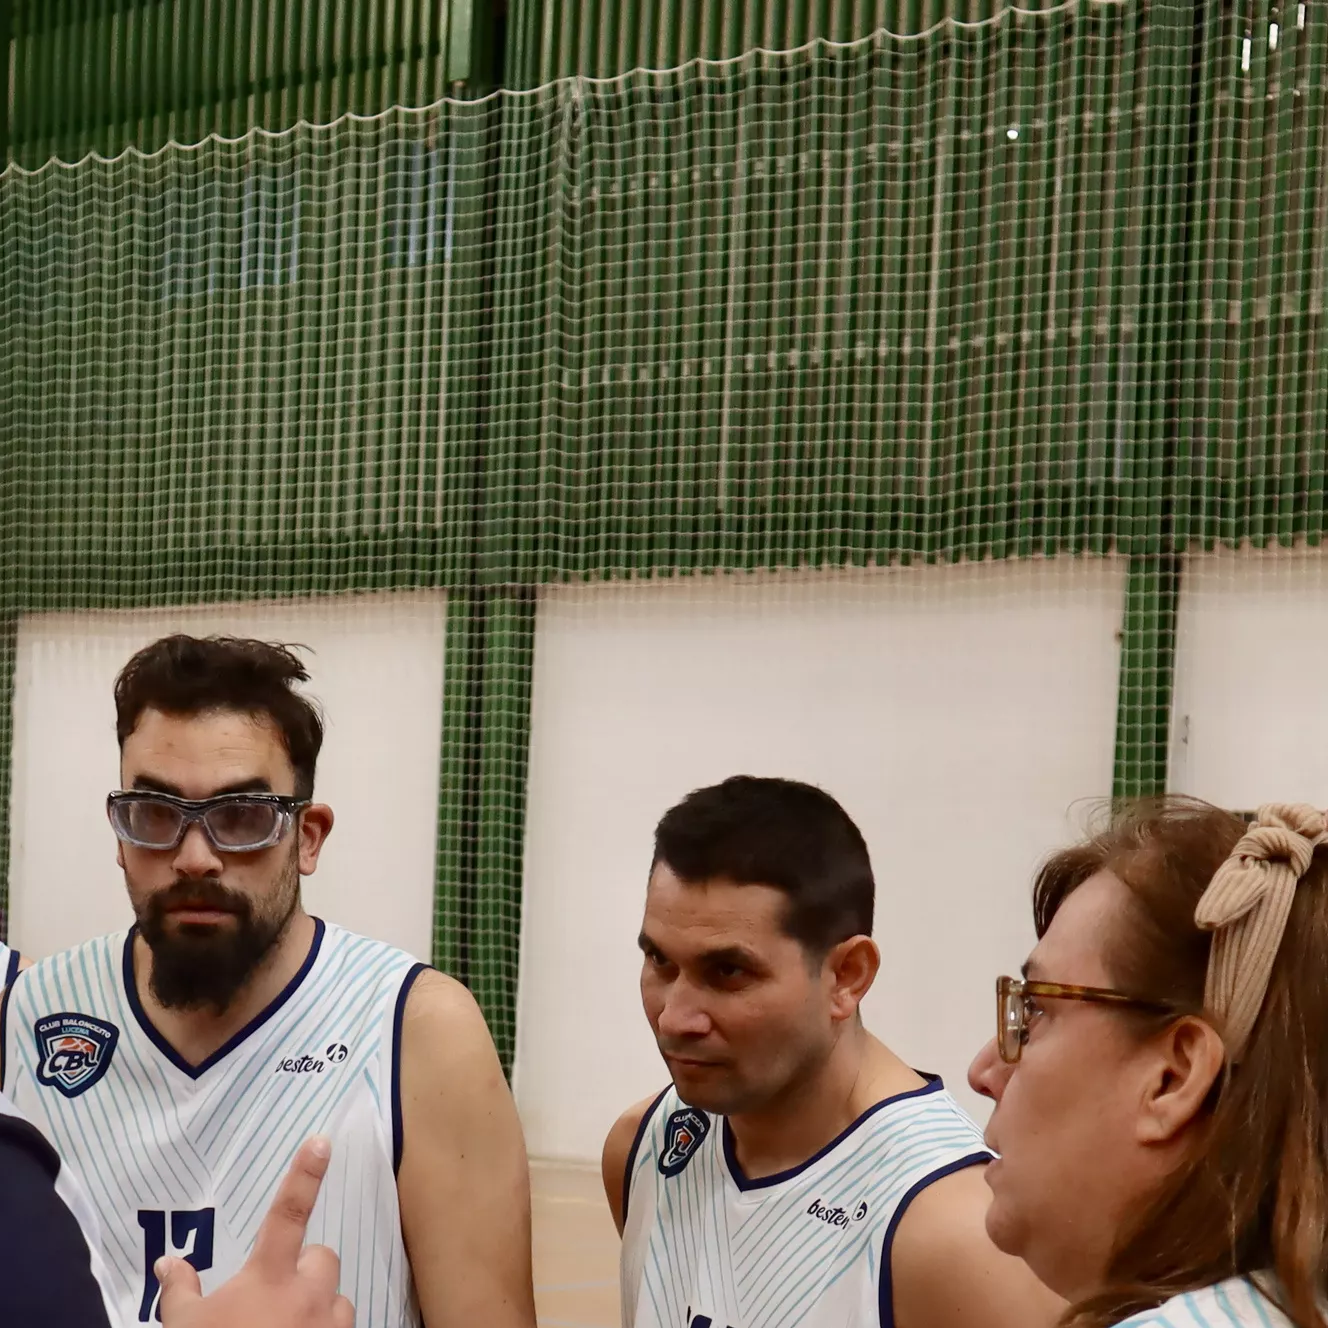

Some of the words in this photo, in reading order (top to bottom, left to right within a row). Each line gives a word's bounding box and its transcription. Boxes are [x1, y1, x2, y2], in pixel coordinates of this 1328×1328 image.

[39, 1020, 61, 1032] CLUB
[62, 1019, 112, 1039] BALONCESTO
[46, 1050, 98, 1074] CBL
[806, 1198, 850, 1230] besten
